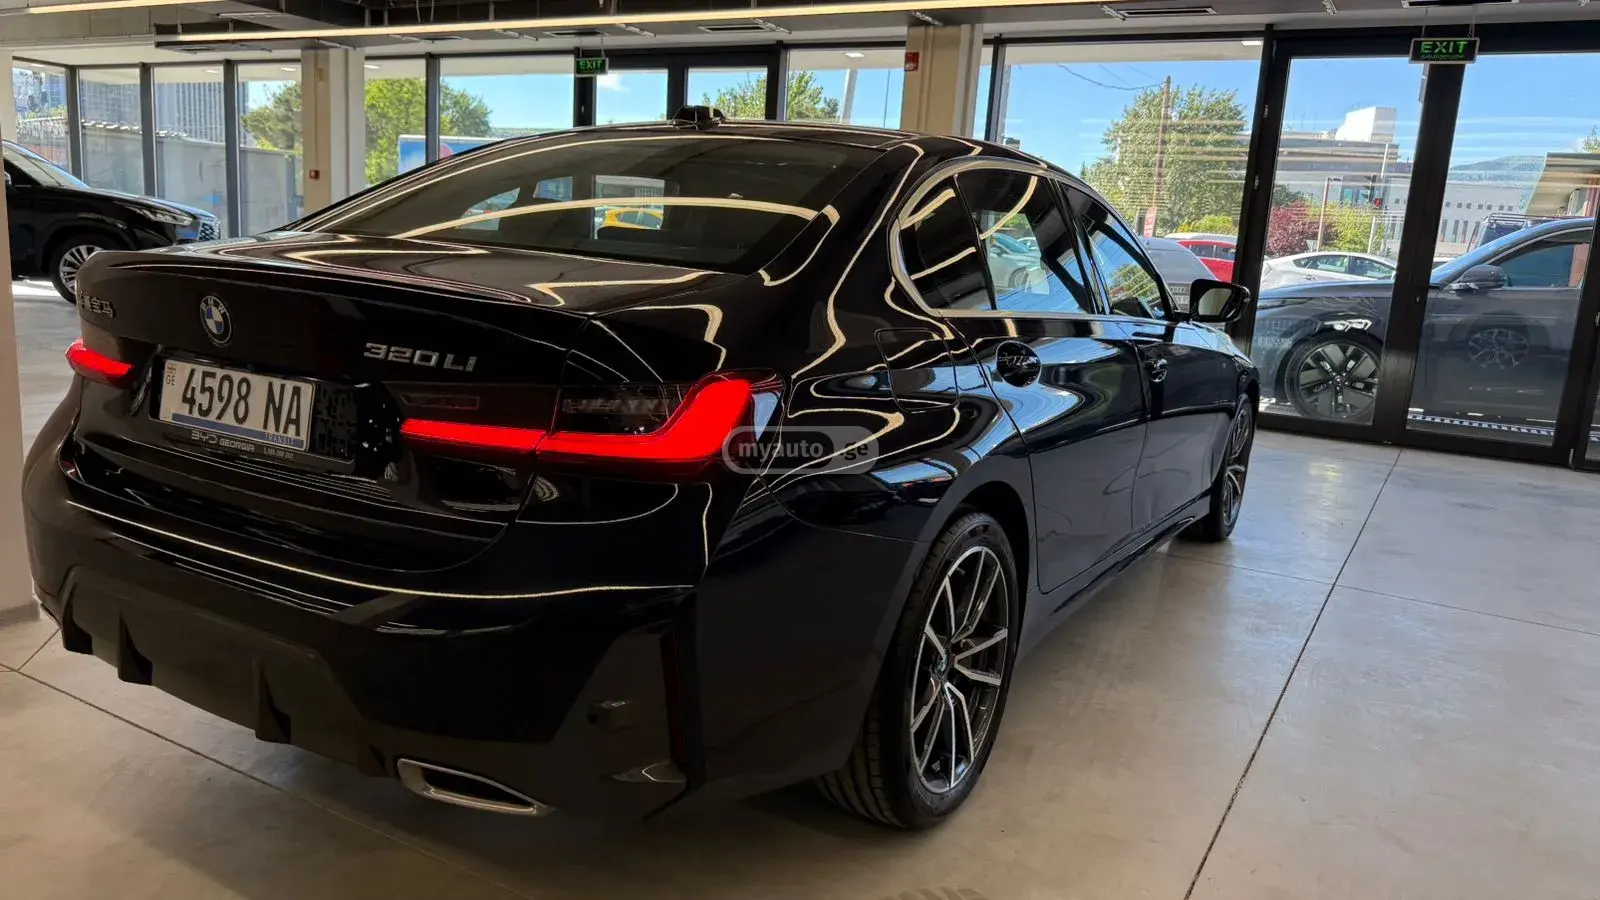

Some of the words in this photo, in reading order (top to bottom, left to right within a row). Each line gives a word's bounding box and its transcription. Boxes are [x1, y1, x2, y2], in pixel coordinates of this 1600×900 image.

[1421, 41, 1468, 53] EXIT
[580, 60, 602, 69] EXIT
[200, 297, 226, 314] BMW
[364, 342, 439, 367] 320
[182, 368, 251, 424] 4598
[263, 381, 301, 436] NA
[191, 430, 218, 444] BYD
[220, 438, 255, 452] GEORGIA
[264, 432, 294, 446] TRANSIT
